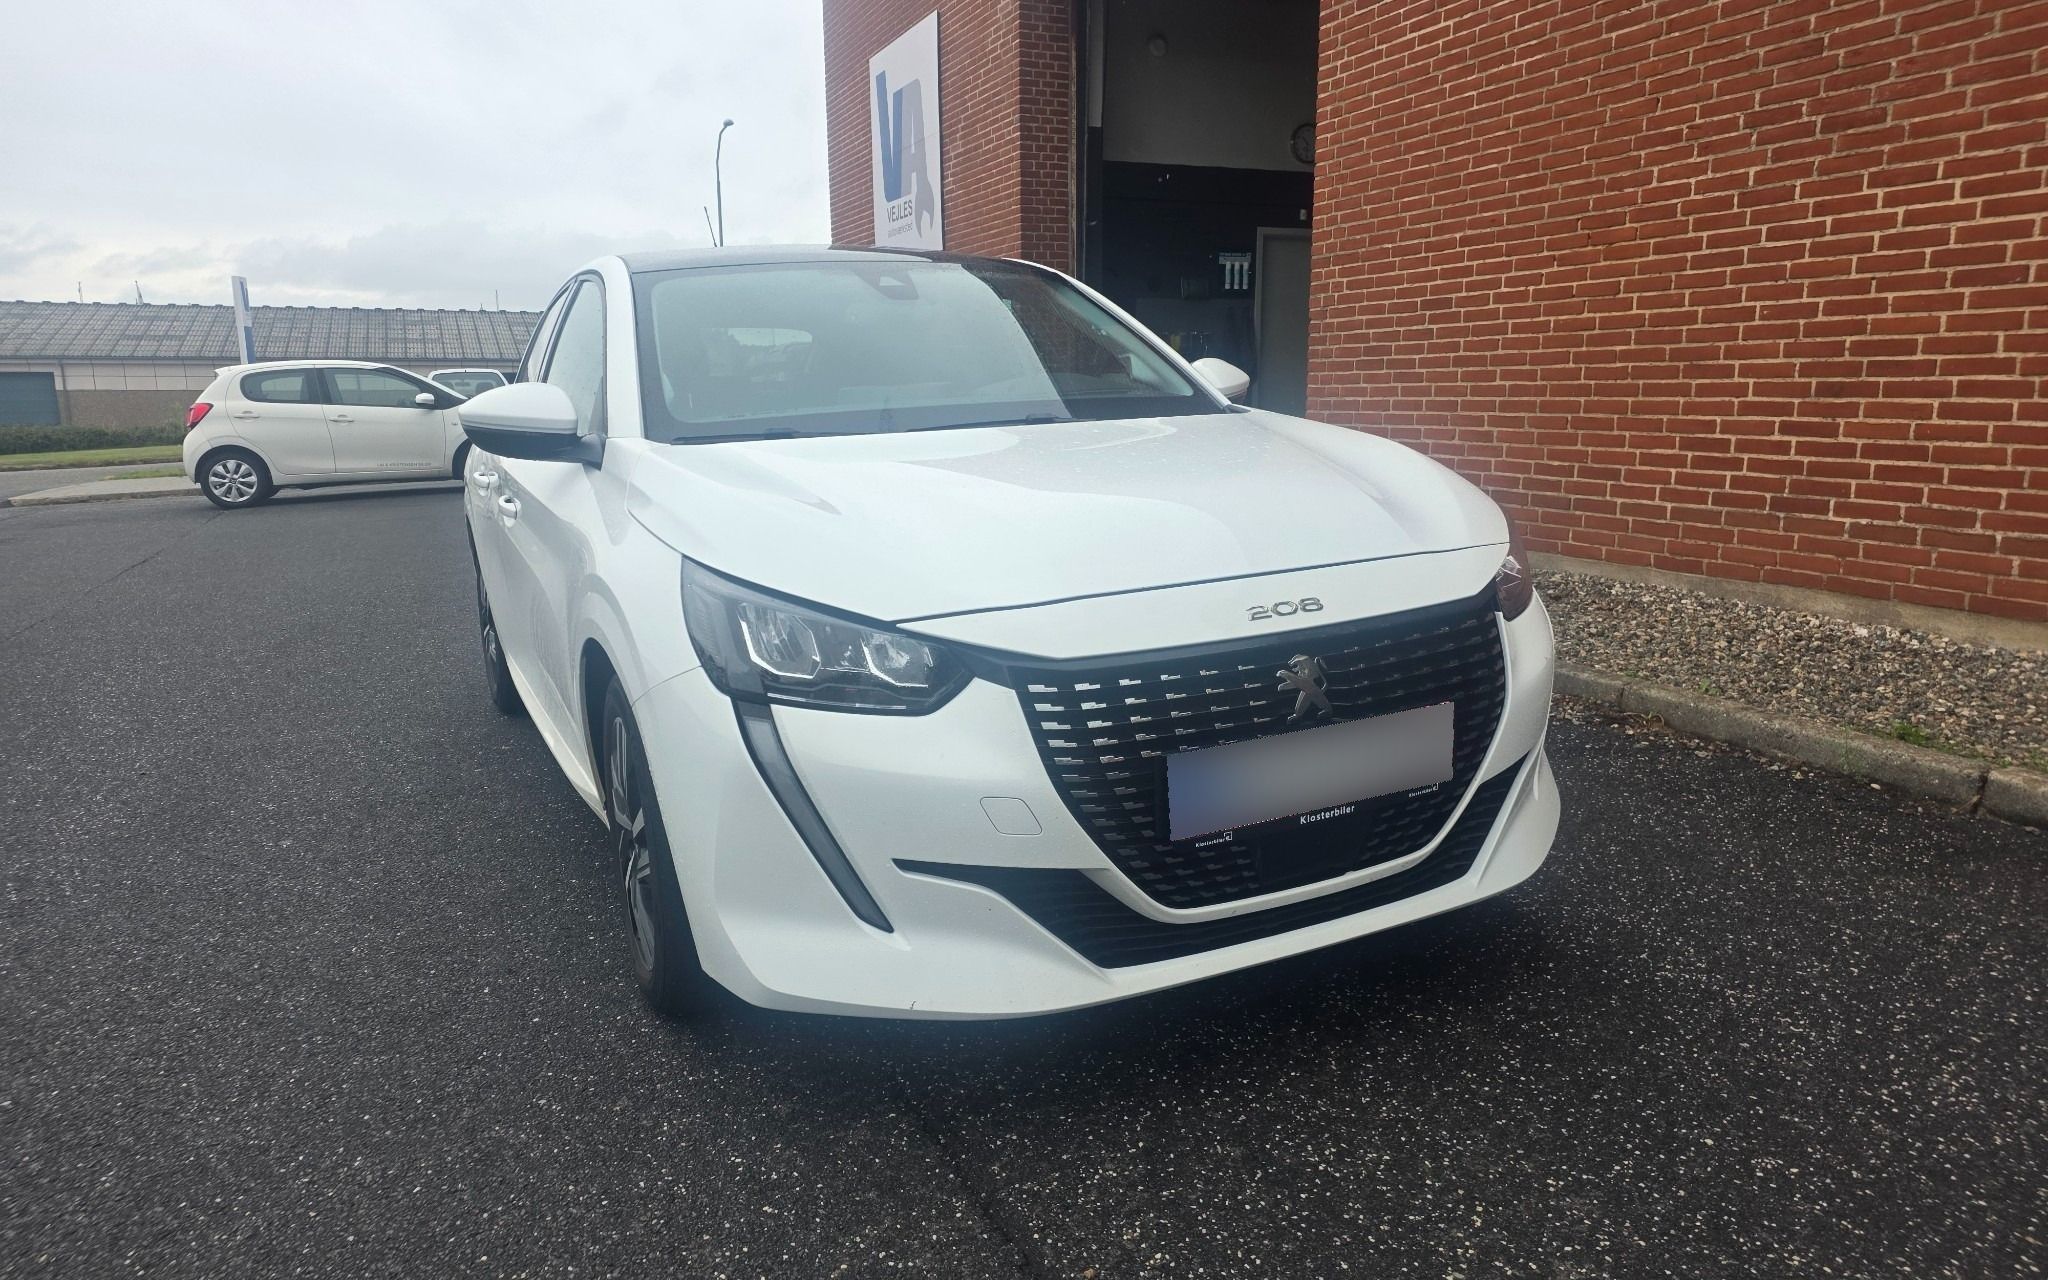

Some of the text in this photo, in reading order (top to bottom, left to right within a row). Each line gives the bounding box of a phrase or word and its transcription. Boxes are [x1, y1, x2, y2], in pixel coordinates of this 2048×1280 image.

[887, 200, 913, 223] VEJLES
[1246, 597, 1323, 621] 208
[1300, 805, 1355, 825] Klosterbiler
